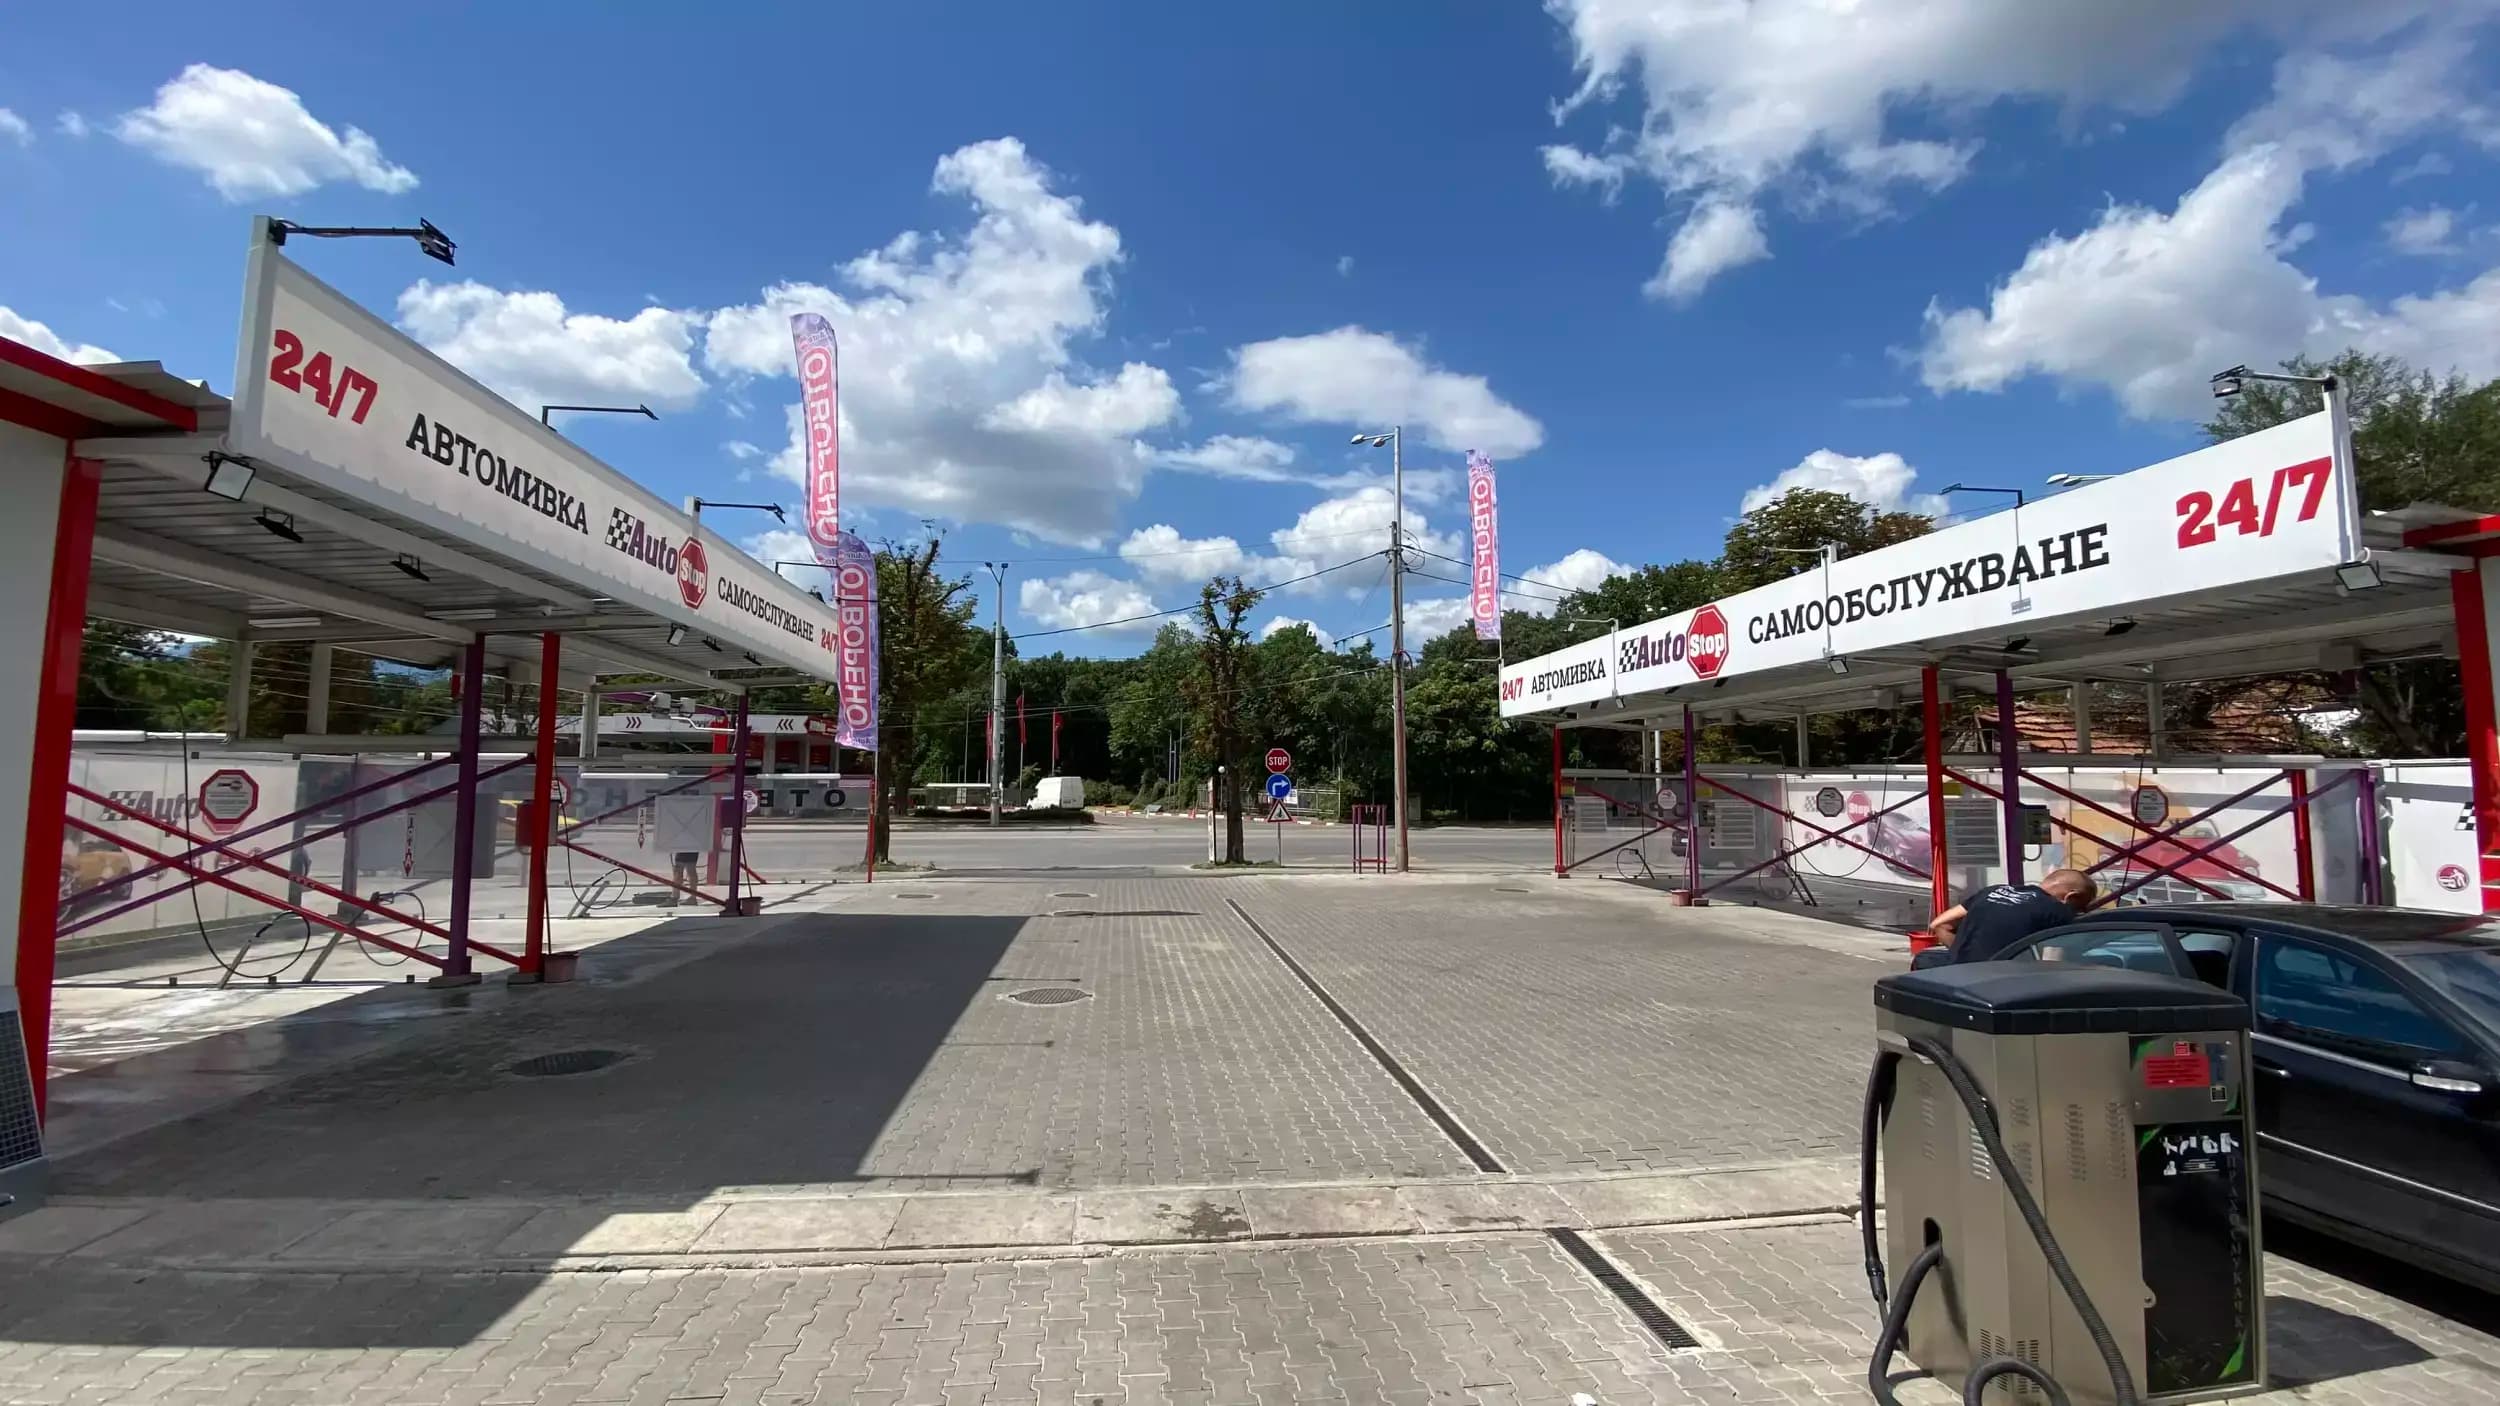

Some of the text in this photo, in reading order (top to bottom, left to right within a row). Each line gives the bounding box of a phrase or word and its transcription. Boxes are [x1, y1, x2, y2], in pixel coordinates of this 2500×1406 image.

[270, 329, 838, 653] 24/7 АВТОМИВКА Auto Stop САМООБСЛУЖВАНЕ 24/7
[1502, 456, 2332, 701] 24/7 АВТОМИВКА Auto Stop САМООБСЛУЖВАНЕ 24/7
[1268, 756, 1288, 766] STOP
